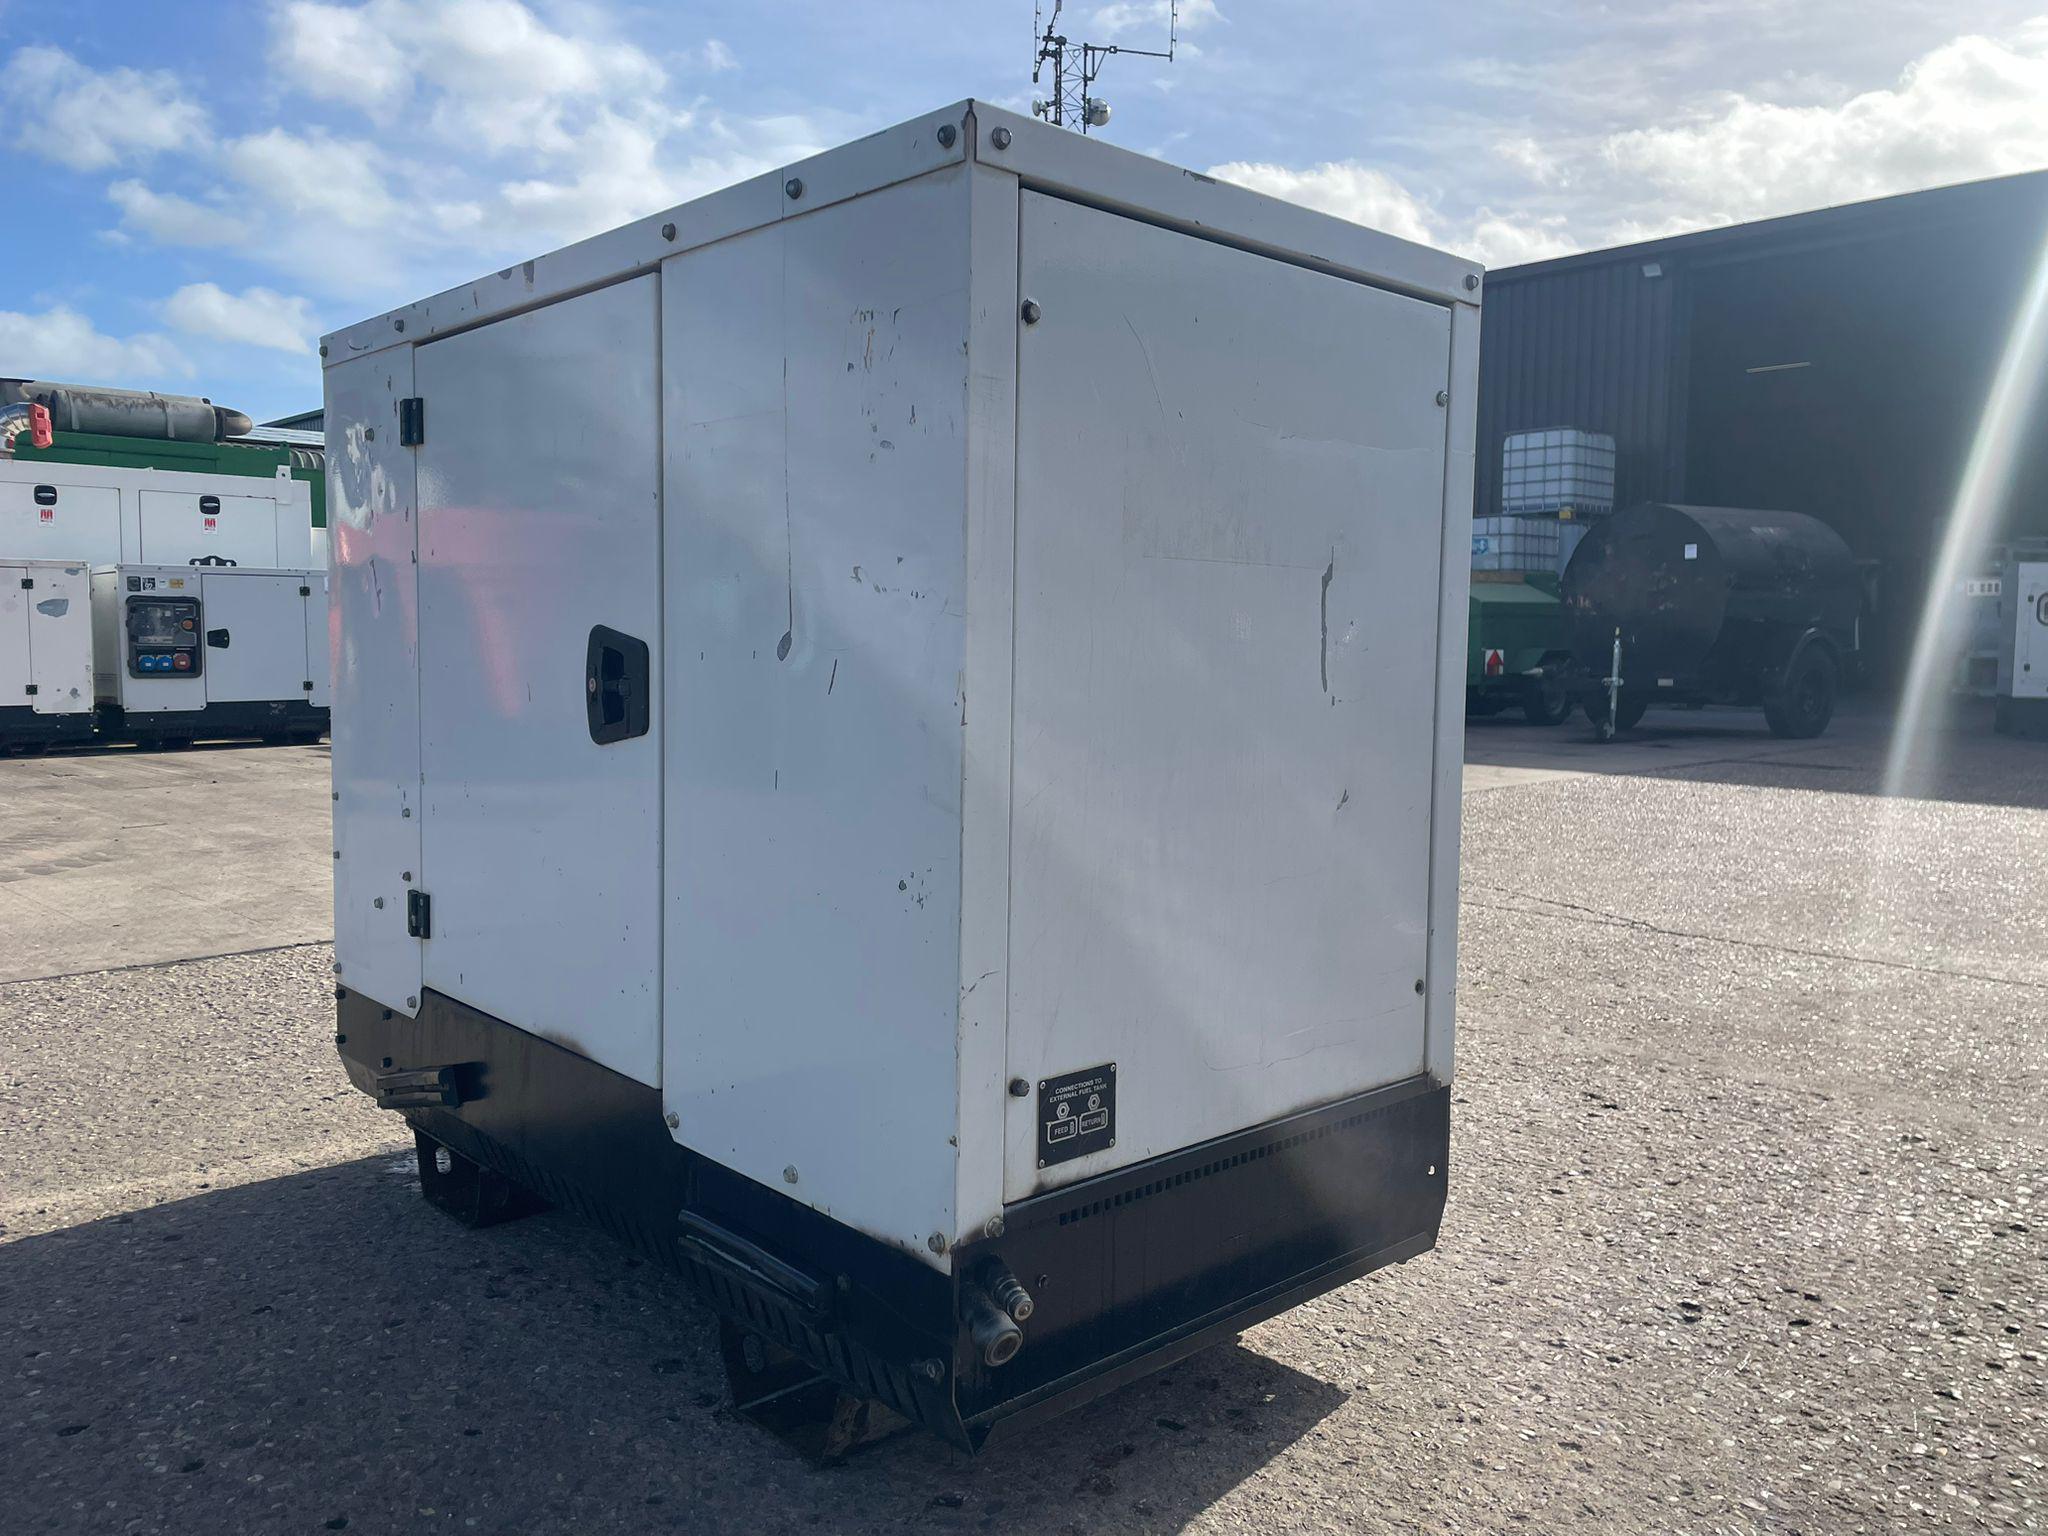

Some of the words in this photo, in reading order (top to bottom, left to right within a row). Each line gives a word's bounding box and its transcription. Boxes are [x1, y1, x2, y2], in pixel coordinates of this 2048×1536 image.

[1055, 1079, 1094, 1094] CONNECTIONS
[1049, 1091, 1078, 1103] EXTERNAL
[1079, 1087, 1092, 1095] FUEL
[1093, 1083, 1107, 1091] TANK
[1081, 1117, 1101, 1127] RETURN
[1054, 1126, 1068, 1135] FEED
